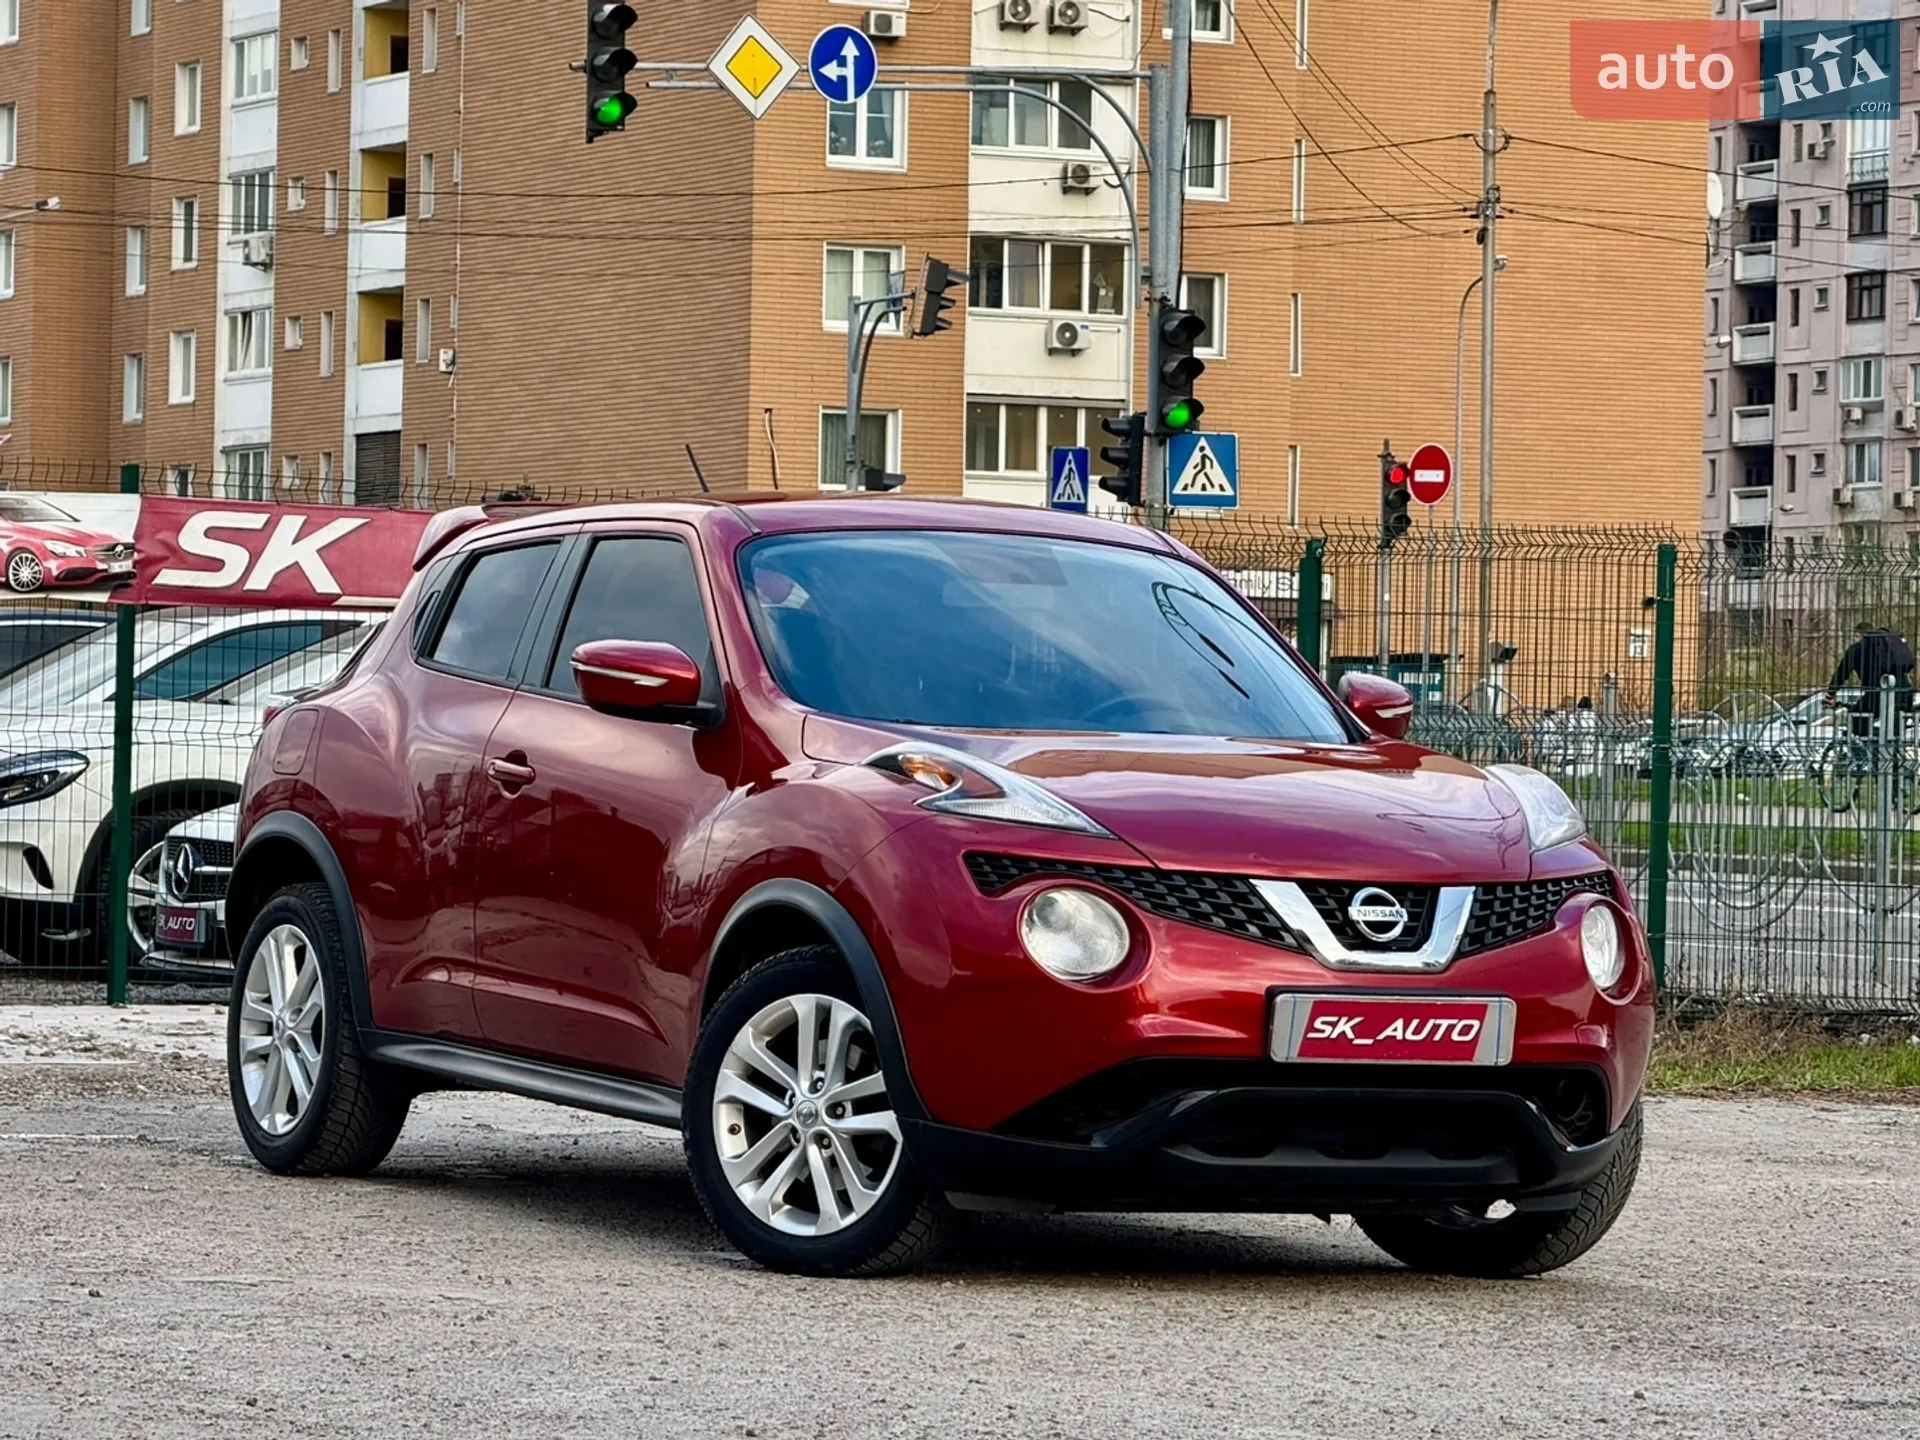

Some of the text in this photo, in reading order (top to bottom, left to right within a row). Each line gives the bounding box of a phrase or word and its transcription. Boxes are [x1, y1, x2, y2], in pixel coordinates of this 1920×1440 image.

[150, 510, 372, 595] SK
[1357, 909, 1404, 919] NISSAN
[1306, 1016, 1481, 1045] SK_AUTO
